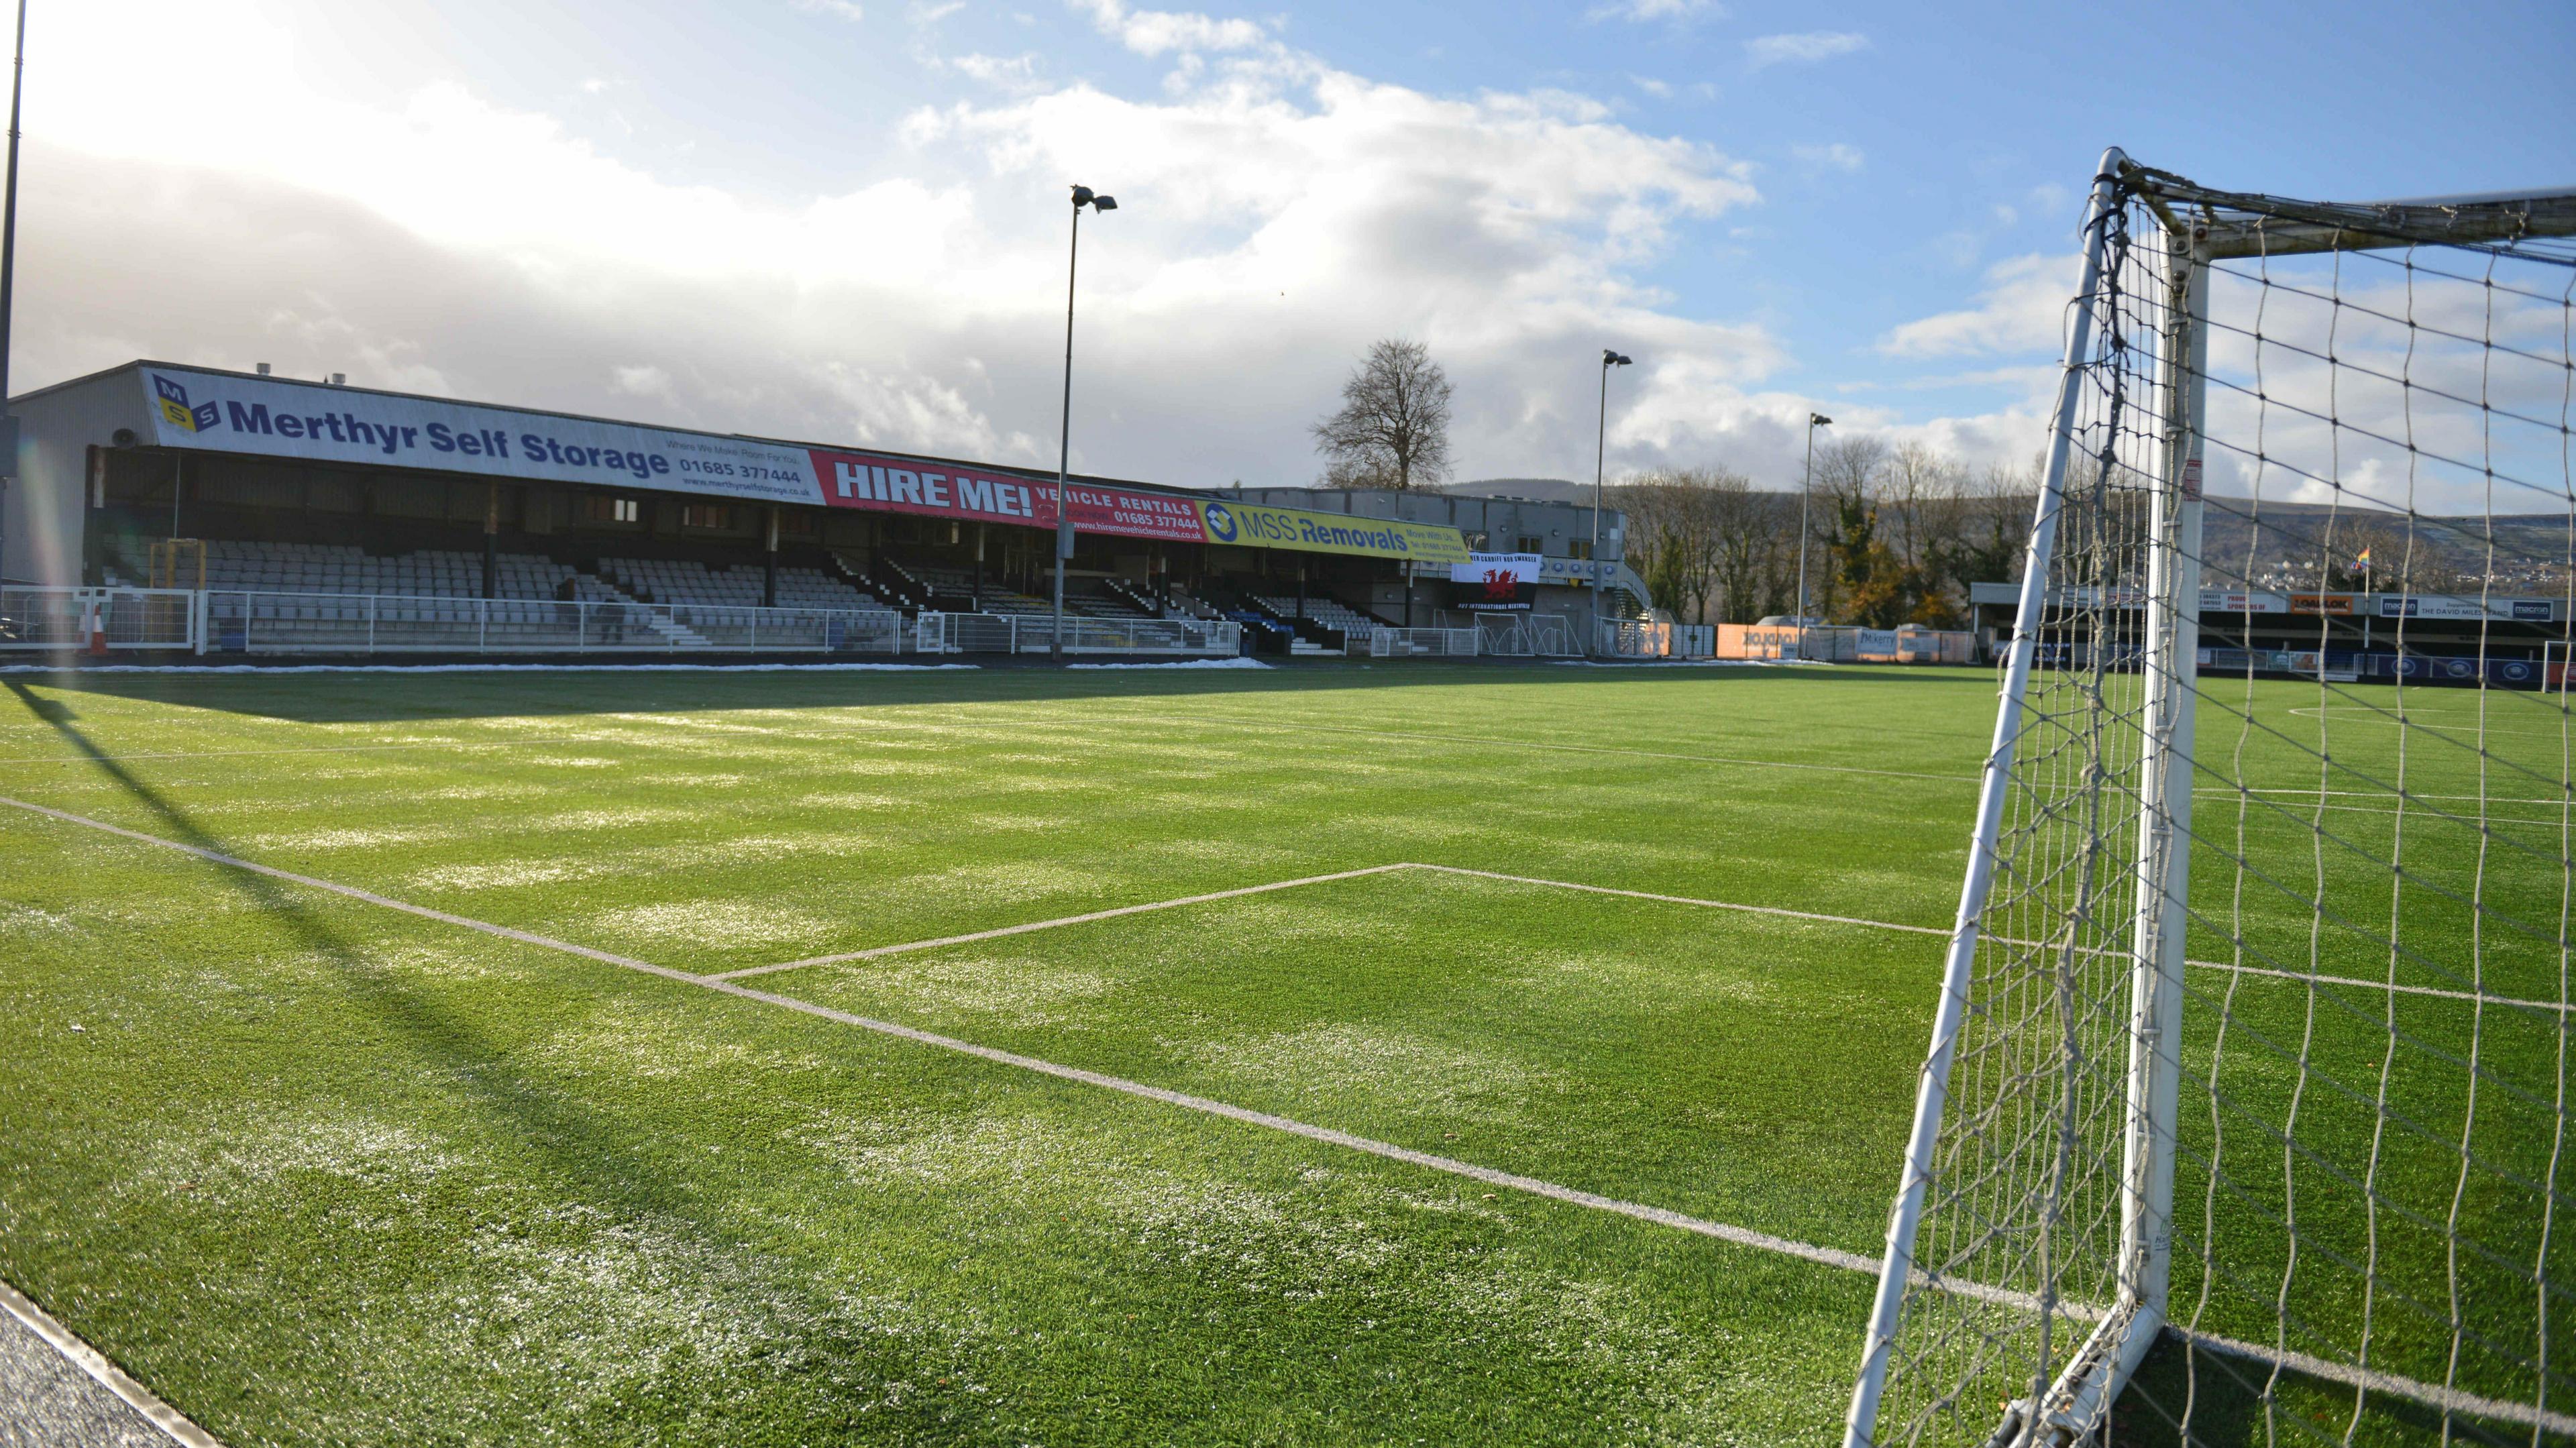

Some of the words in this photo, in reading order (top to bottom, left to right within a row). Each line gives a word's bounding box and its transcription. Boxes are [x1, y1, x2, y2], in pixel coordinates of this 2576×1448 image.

[226, 400, 418, 455] Merthyr
[425, 423, 508, 459] Self
[521, 434, 670, 480] Storage
[666, 440, 696, 451] Where
[698, 443, 712, 453] We
[714, 446, 737, 457] Make
[741, 449, 766, 460] Room
[767, 452, 781, 461] For
[680, 459, 735, 476] 01685
[738, 465, 801, 483] 377444
[682, 478, 811, 496] www.merthyrselfstorage.co.uk
[834, 461, 951, 508] HIRE
[955, 477, 1033, 518] ME!
[1035, 487, 1113, 507] VEHICLE
[1118, 497, 1192, 516] RENTALS
[1074, 522, 1202, 540] www.hiremevehiclerentals.co.uk
[1114, 511, 1153, 526] 01685
[1157, 515, 1200, 530] 377444
[1239, 511, 1297, 541] MSS
[1299, 518, 1407, 551] Removals
